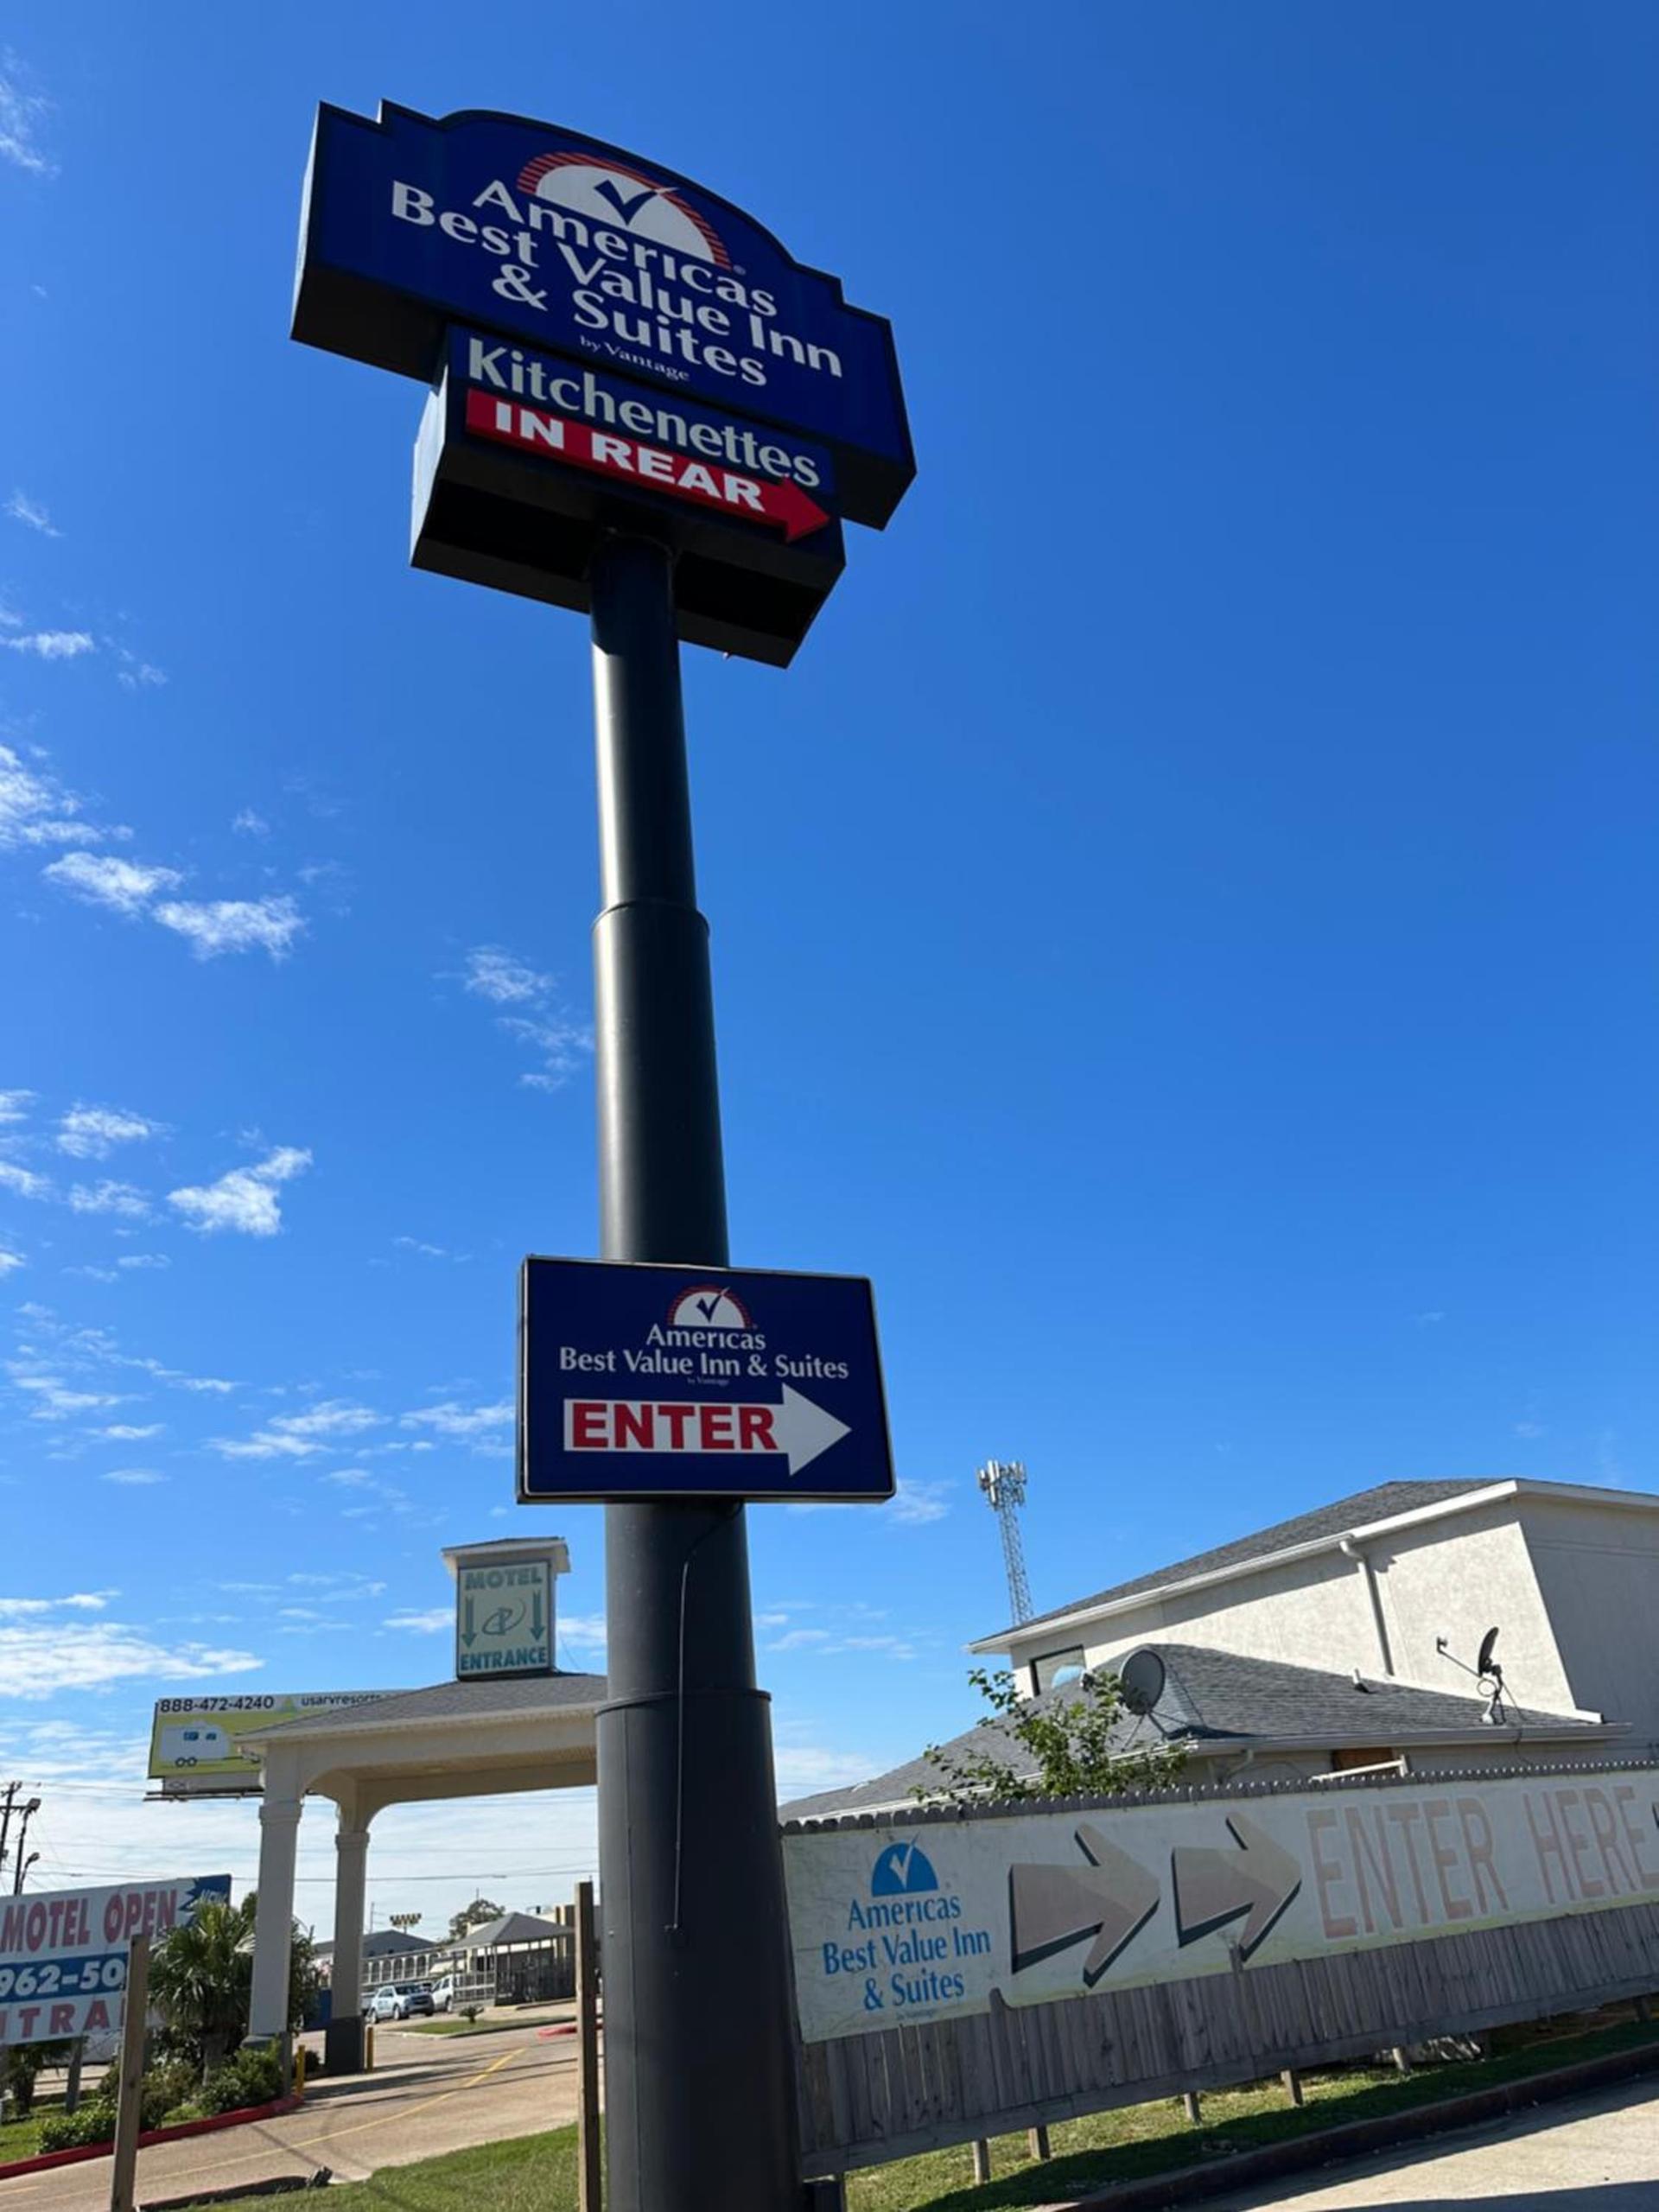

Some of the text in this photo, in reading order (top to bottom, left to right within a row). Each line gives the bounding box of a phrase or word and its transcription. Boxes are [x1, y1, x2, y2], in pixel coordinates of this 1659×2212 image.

[472, 180, 777, 316] Americas
[391, 180, 842, 378] Best Value Inn
[492, 264, 767, 386] & Suites
[580, 334, 690, 381] by Vantage
[469, 338, 820, 487] Kitchenettes
[495, 400, 766, 512] IN REAR
[645, 1323, 766, 1351] Americas
[559, 1346, 849, 1379] Best Value Inn & Suites
[571, 1402, 779, 1451] ENTER
[465, 1567, 543, 1590] MOTEL
[461, 1646, 546, 1671] ENTRANCE
[161, 1696, 274, 1713] 888-472-4240
[1306, 1785, 1659, 1940] ENTER HERE
[1, 1890, 177, 1953] MOTEL OPEN
[849, 1896, 962, 1931] Americas
[823, 1927, 991, 1975] Best Value Inn
[864, 1967, 965, 2011] & Suites
[0, 1997, 125, 2038] TRA
